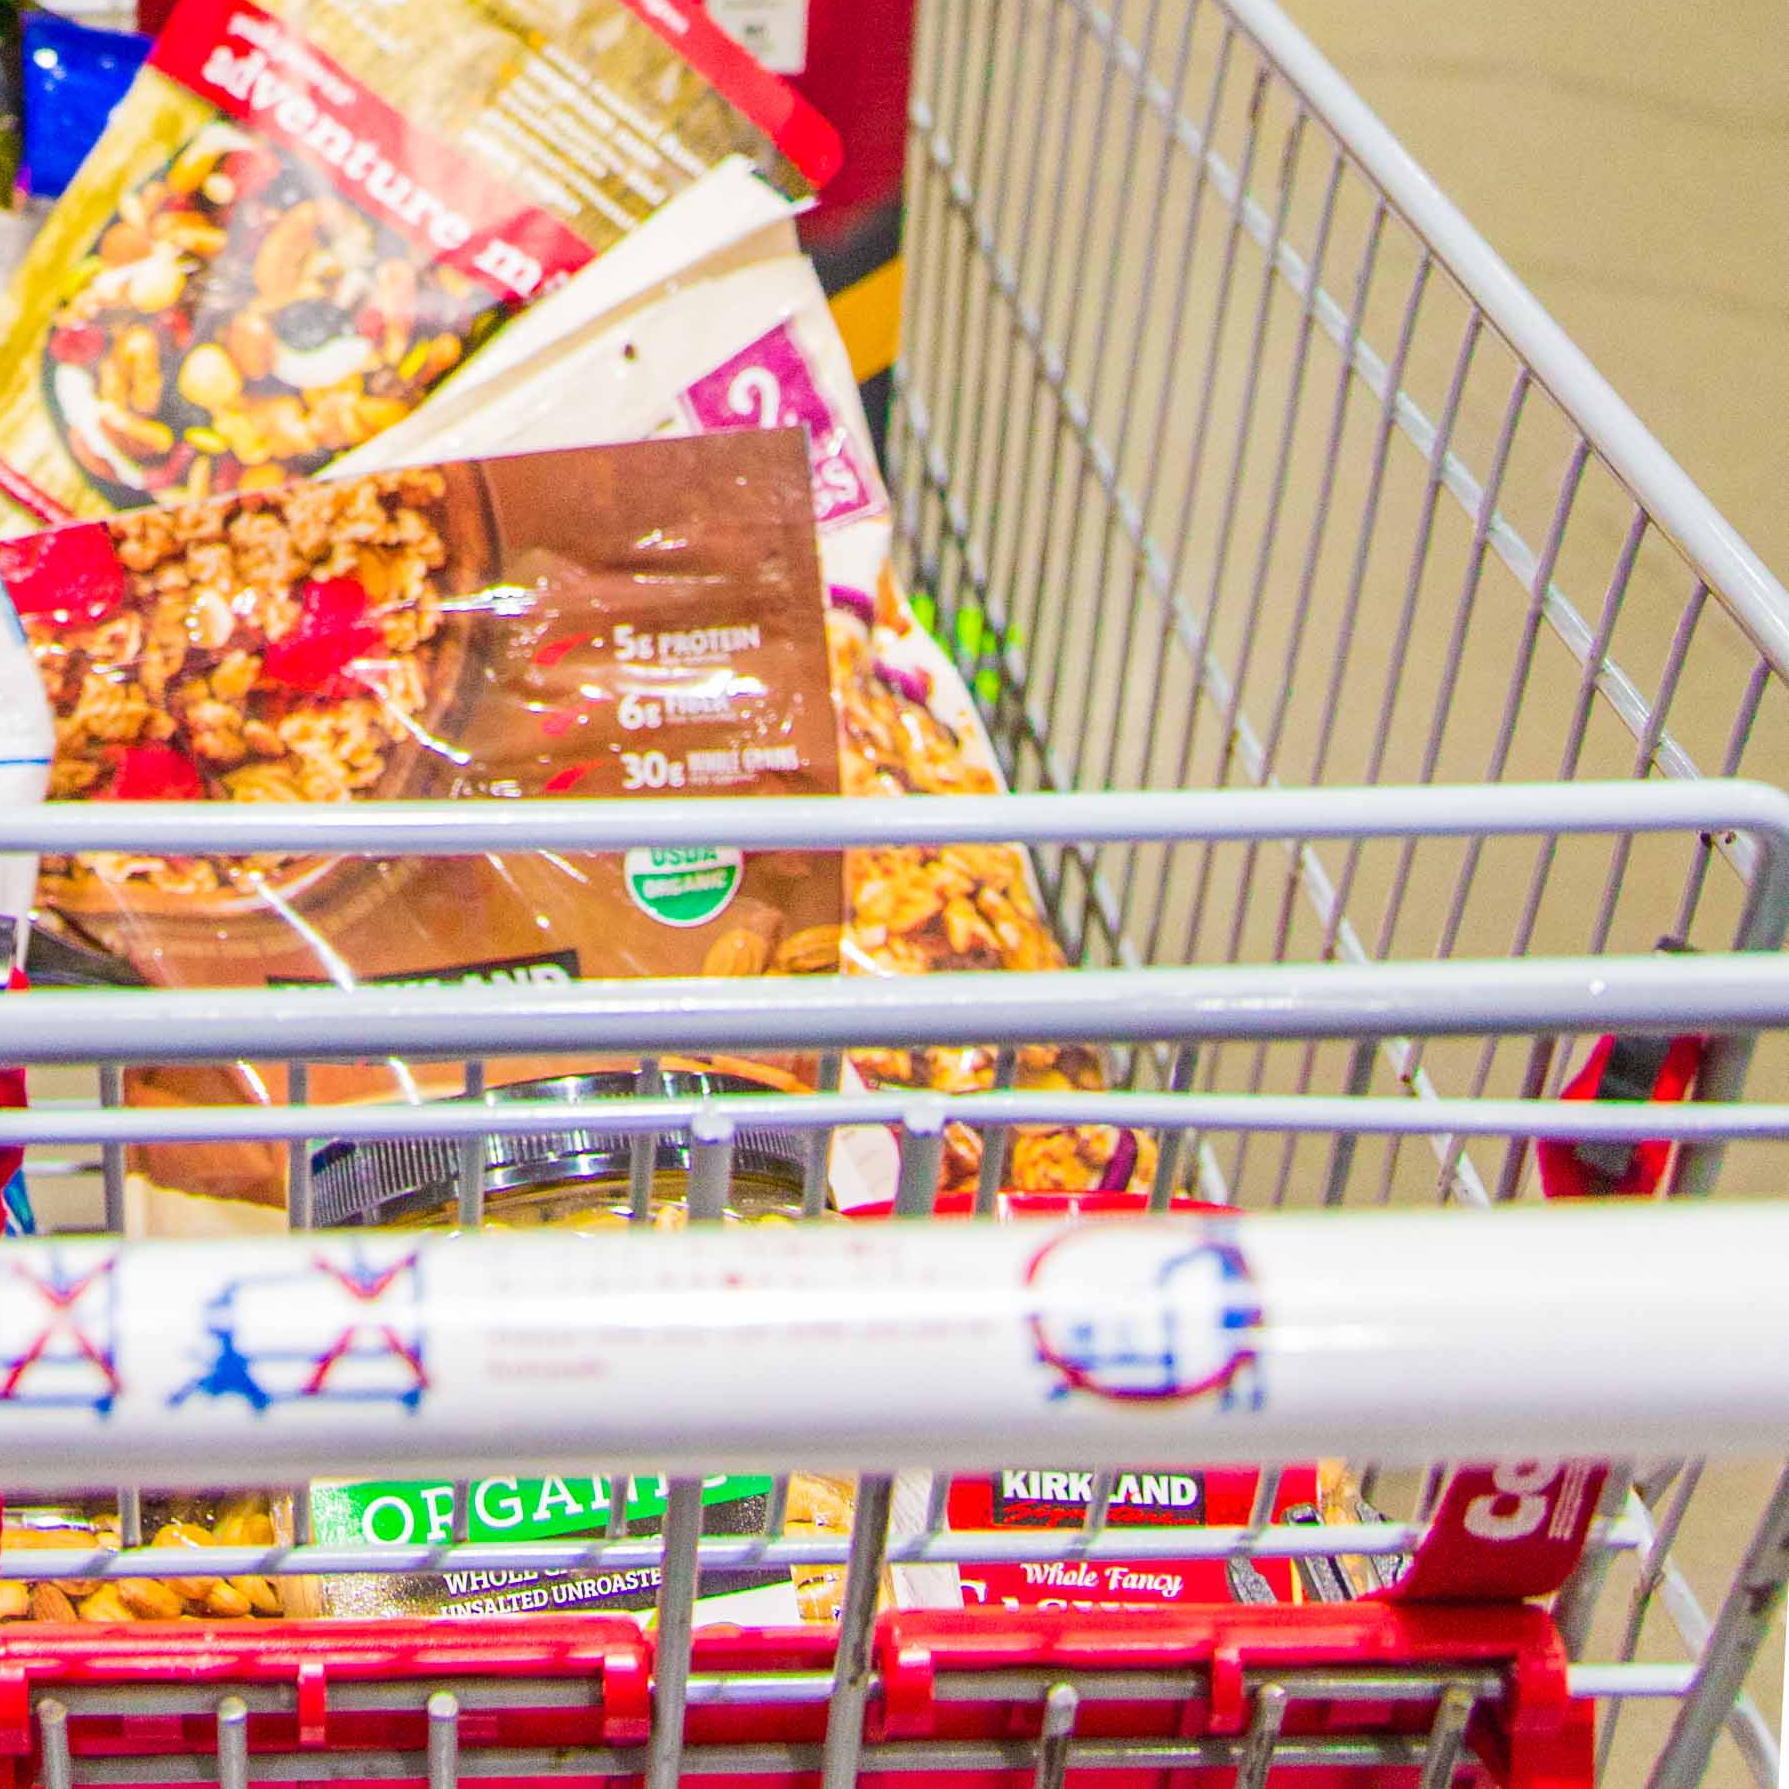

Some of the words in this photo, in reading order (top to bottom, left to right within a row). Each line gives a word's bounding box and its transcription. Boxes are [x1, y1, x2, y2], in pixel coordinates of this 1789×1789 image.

[202, 45, 472, 250] adventure
[612, 624, 654, 661] 5g
[658, 625, 762, 659] PROTEIN
[617, 692, 663, 731] 6g
[620, 749, 687, 791] 30g
[642, 870, 730, 900] ORGANIC
[441, 1588, 549, 1619] UNSALTED
[552, 1568, 663, 1604] UNROASTE
[1020, 1562, 1099, 1588] Whole
[1104, 1566, 1184, 1598] Fancy
